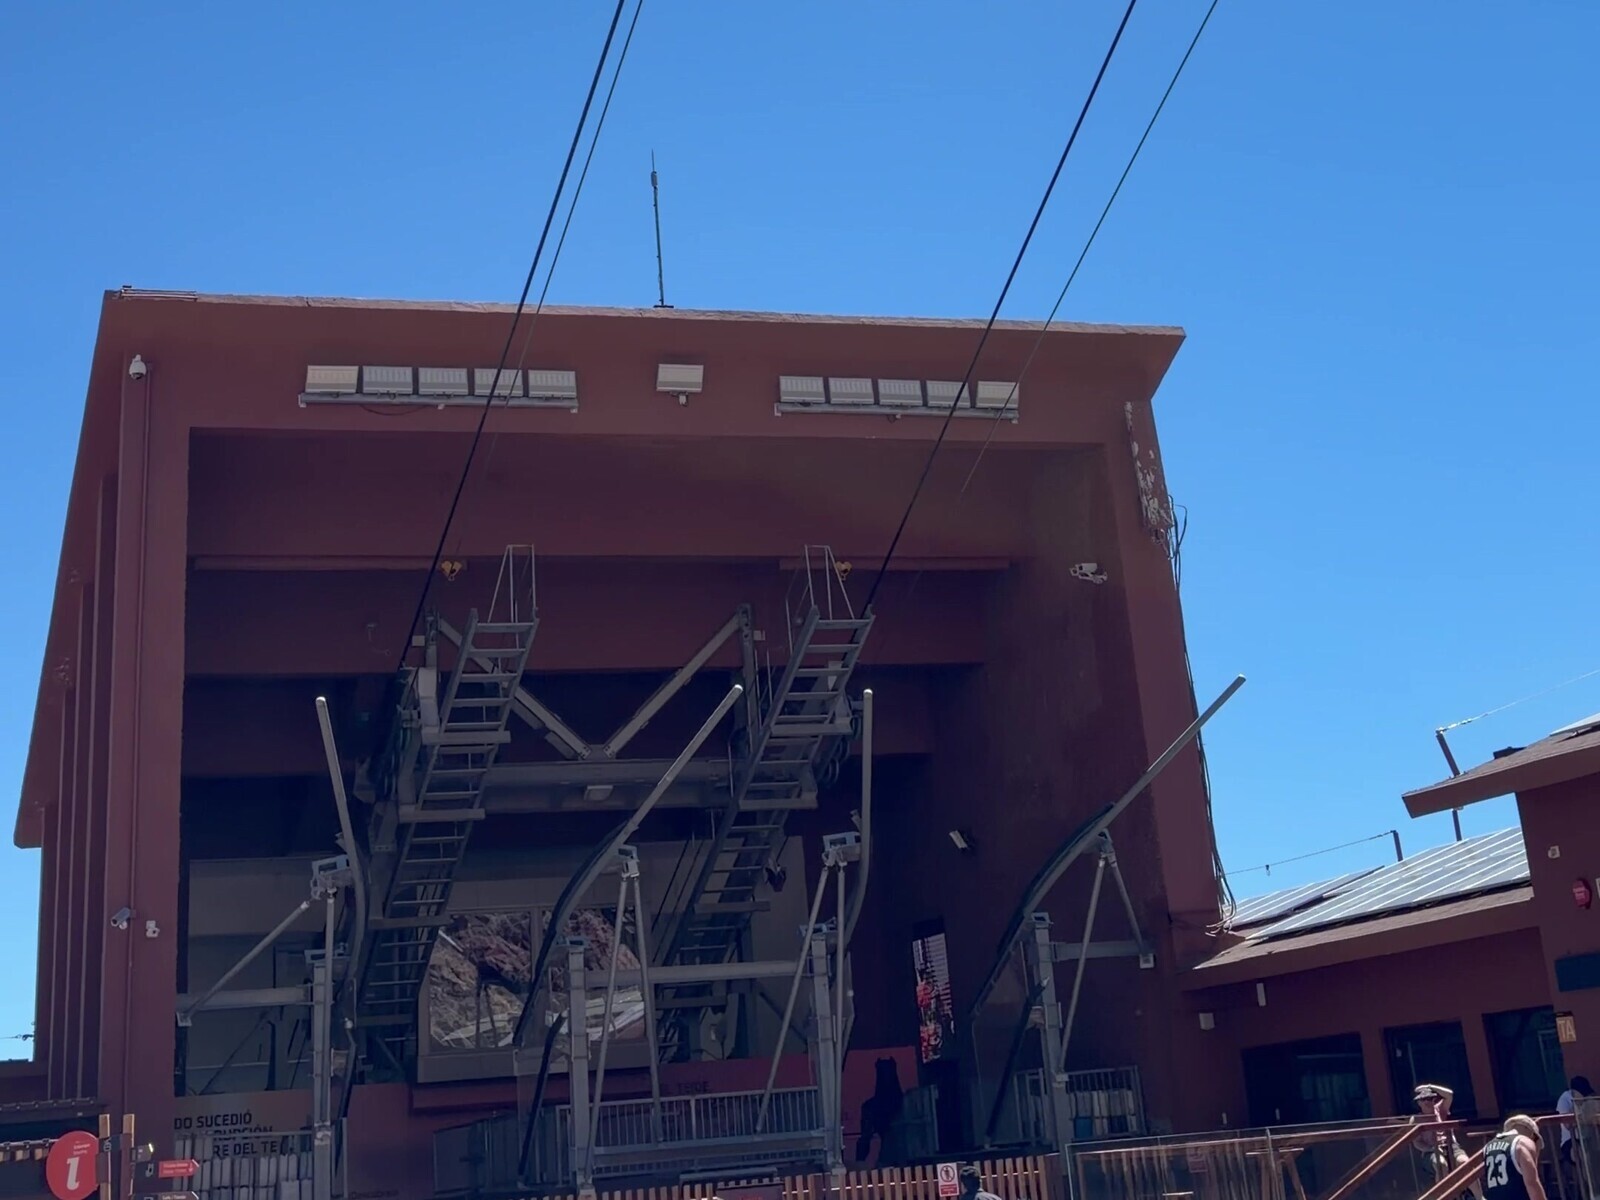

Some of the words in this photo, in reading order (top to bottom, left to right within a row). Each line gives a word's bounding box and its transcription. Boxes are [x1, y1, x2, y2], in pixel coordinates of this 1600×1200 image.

[174, 1117, 192, 1130] DO
[196, 1109, 252, 1128] SUCEDIÓ
[213, 1125, 273, 1142] RUPCIÓN
[233, 1142, 257, 1155] DEL
[1486, 1153, 1509, 1189] 23
